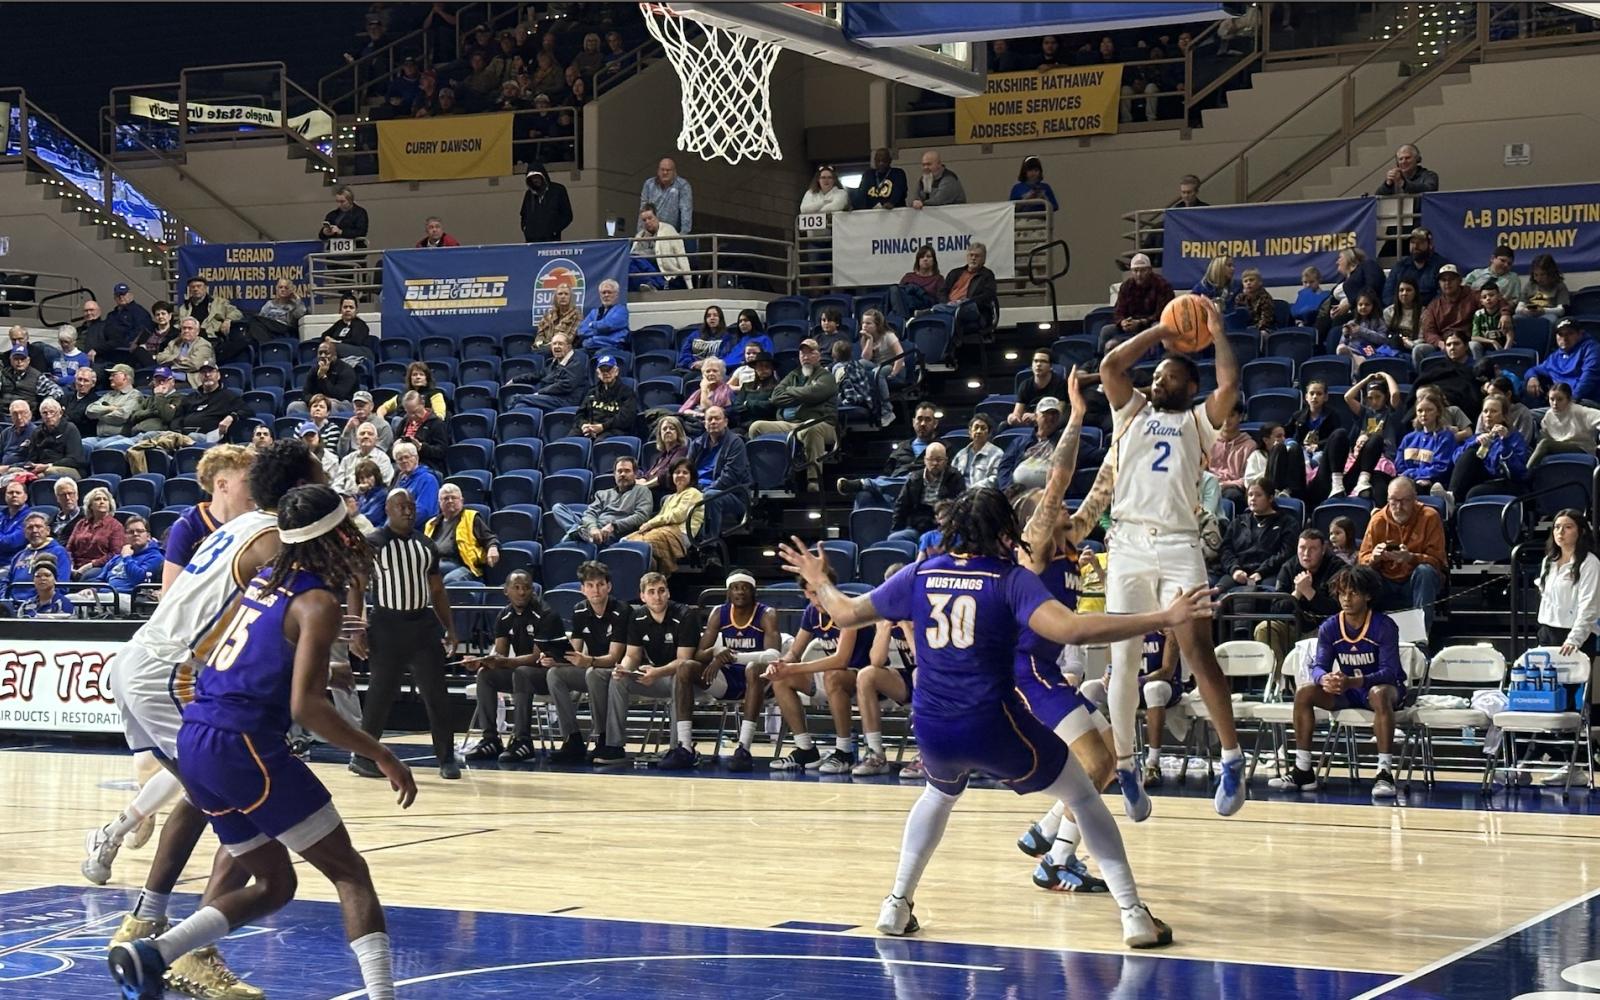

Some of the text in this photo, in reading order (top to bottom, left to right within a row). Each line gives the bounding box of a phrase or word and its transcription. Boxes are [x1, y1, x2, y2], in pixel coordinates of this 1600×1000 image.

[984, 72, 1105, 94] RKSHIRE HATHAWAY
[989, 96, 1082, 116] HOME SERVICES
[970, 114, 1101, 139] ADDRESSES, REALTORS
[405, 138, 482, 154] CURRY DAWSON
[801, 216, 823, 228] 103
[1463, 209, 1492, 229] A-B
[332, 241, 351, 251] 103
[937, 234, 973, 251] BANK
[1181, 231, 1357, 259] PRINCIPAL INDUSTRIES
[1496, 228, 1578, 250] COMPANY
[226, 248, 275, 263] LEGRAND
[537, 248, 584, 257] PRESENTED BY
[198, 265, 304, 281] HEADWATERS RANCH
[245, 285, 268, 299] BOB
[1143, 420, 1183, 437] Rams
[1151, 441, 1171, 472] 2
[184, 530, 235, 575] 23
[926, 577, 983, 590] MUSTANGS
[925, 593, 977, 650] 30
[206, 604, 263, 672] 15
[725, 637, 756, 649] WNMU
[1338, 652, 1376, 666] WNMU
[14, 711, 50, 722] DUCTS
